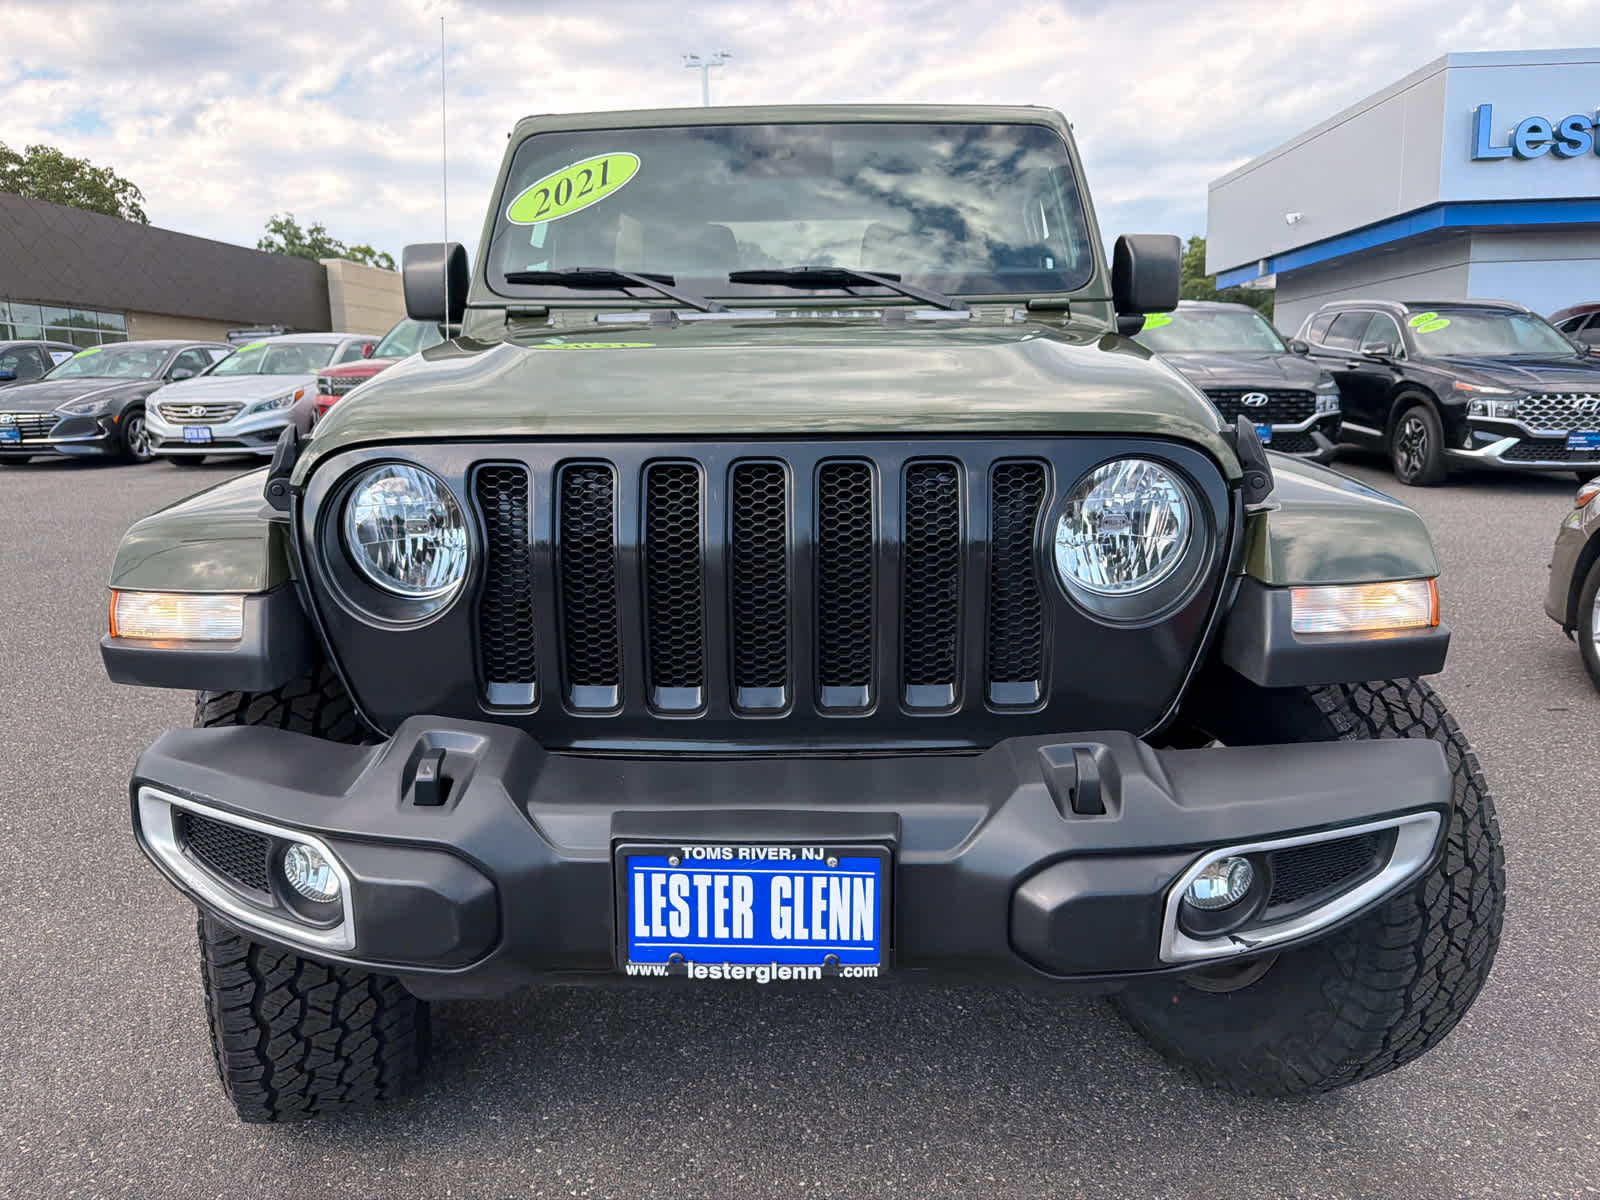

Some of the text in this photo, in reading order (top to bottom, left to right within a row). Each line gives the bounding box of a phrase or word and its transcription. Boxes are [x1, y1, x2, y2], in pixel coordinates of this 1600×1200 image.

[533, 159, 612, 219] 2021
[681, 847, 824, 861] TOMS RIVER, NJ
[634, 872, 875, 941] LESTER GLENN
[625, 960, 879, 984] www. lesterglenn .com
